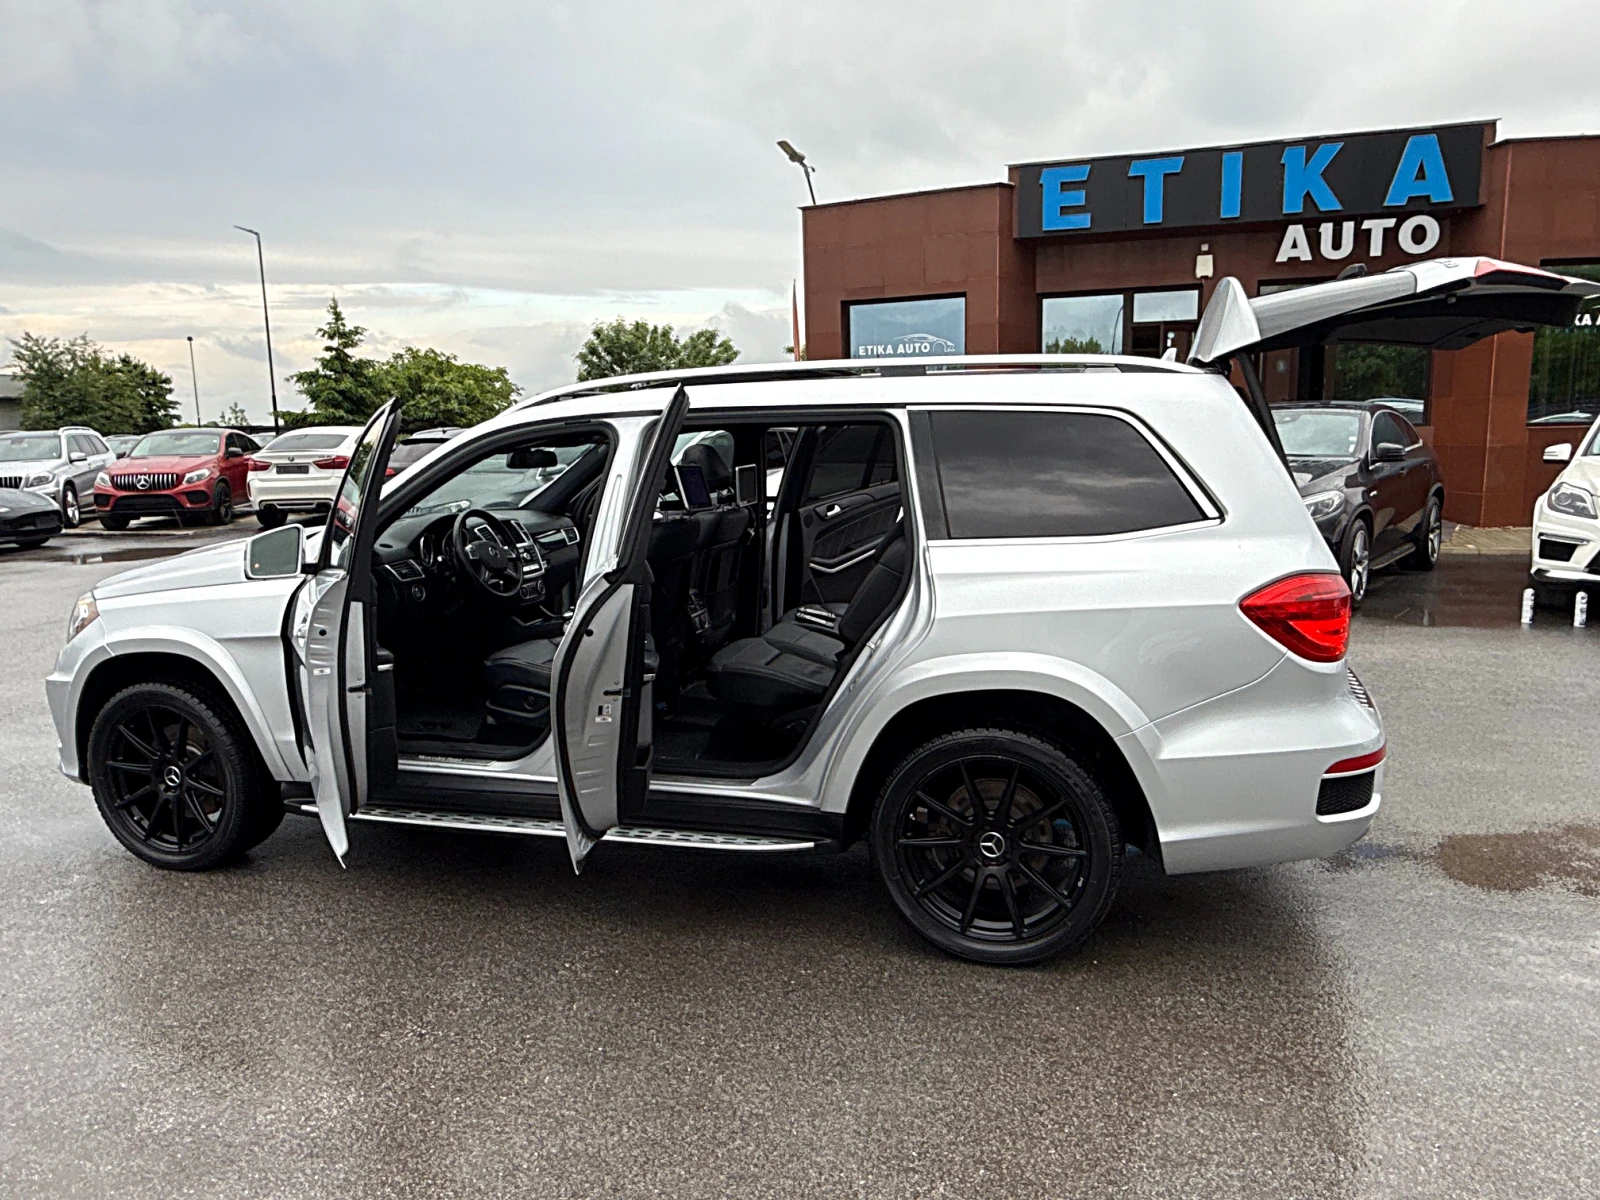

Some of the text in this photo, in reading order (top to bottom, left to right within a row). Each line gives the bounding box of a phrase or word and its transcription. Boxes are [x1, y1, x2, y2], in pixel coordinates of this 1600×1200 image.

[1040, 134, 1454, 231] ETIKA
[1275, 215, 1440, 263] AUTO
[858, 342, 930, 356] ETIKA AUTO
